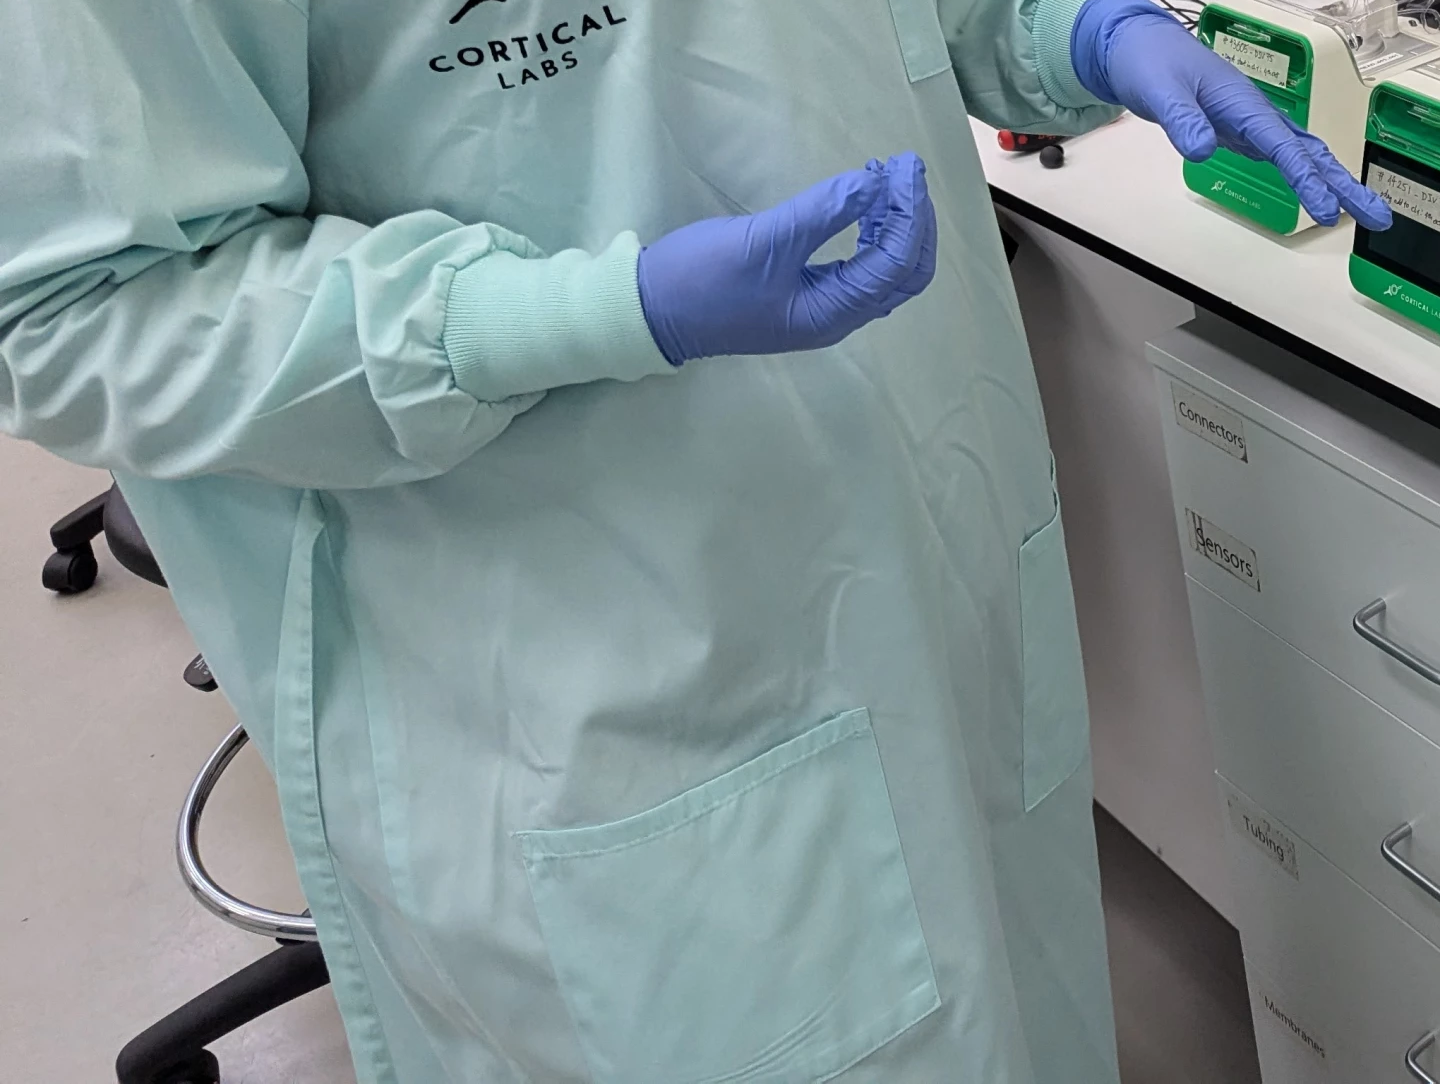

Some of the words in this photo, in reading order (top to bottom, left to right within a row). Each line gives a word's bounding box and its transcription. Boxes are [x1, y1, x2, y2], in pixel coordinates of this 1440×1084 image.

[429, 5, 627, 73] CORTICAL
[498, 51, 578, 90] LABS
[1401, 293, 1429, 313] CORTICAL
[1179, 401, 1245, 449] Connectors
[1196, 527, 1254, 577] Sensors
[1243, 815, 1285, 861] Tubing
[1264, 996, 1326, 1059] Membranes
